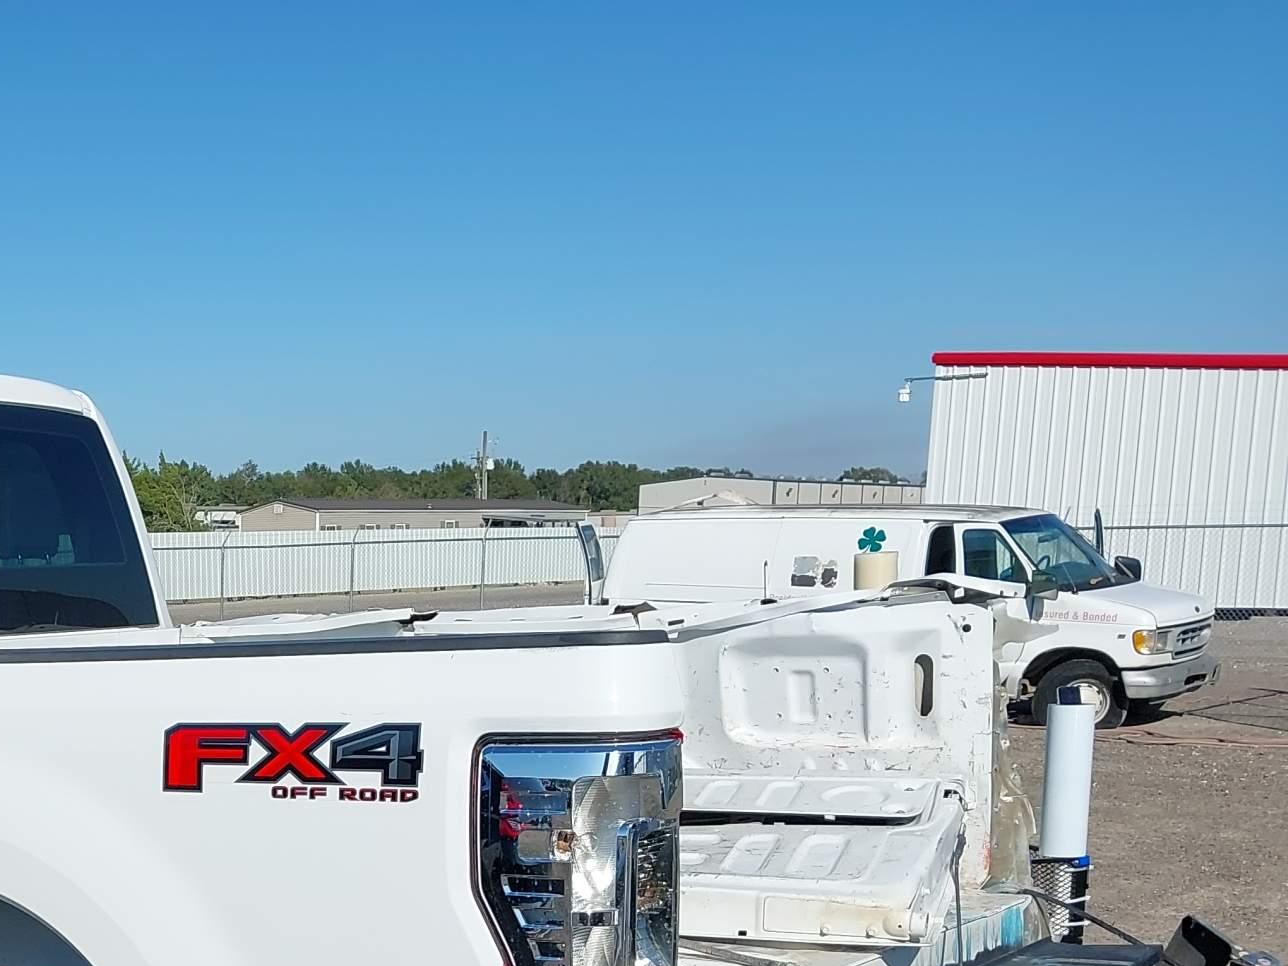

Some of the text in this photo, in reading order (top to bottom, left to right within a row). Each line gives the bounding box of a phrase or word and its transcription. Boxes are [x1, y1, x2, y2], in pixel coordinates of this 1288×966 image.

[1044, 609, 1118, 622] sured & Bonded
[162, 722, 424, 793] FX4
[271, 785, 419, 802] OFF ROAD
